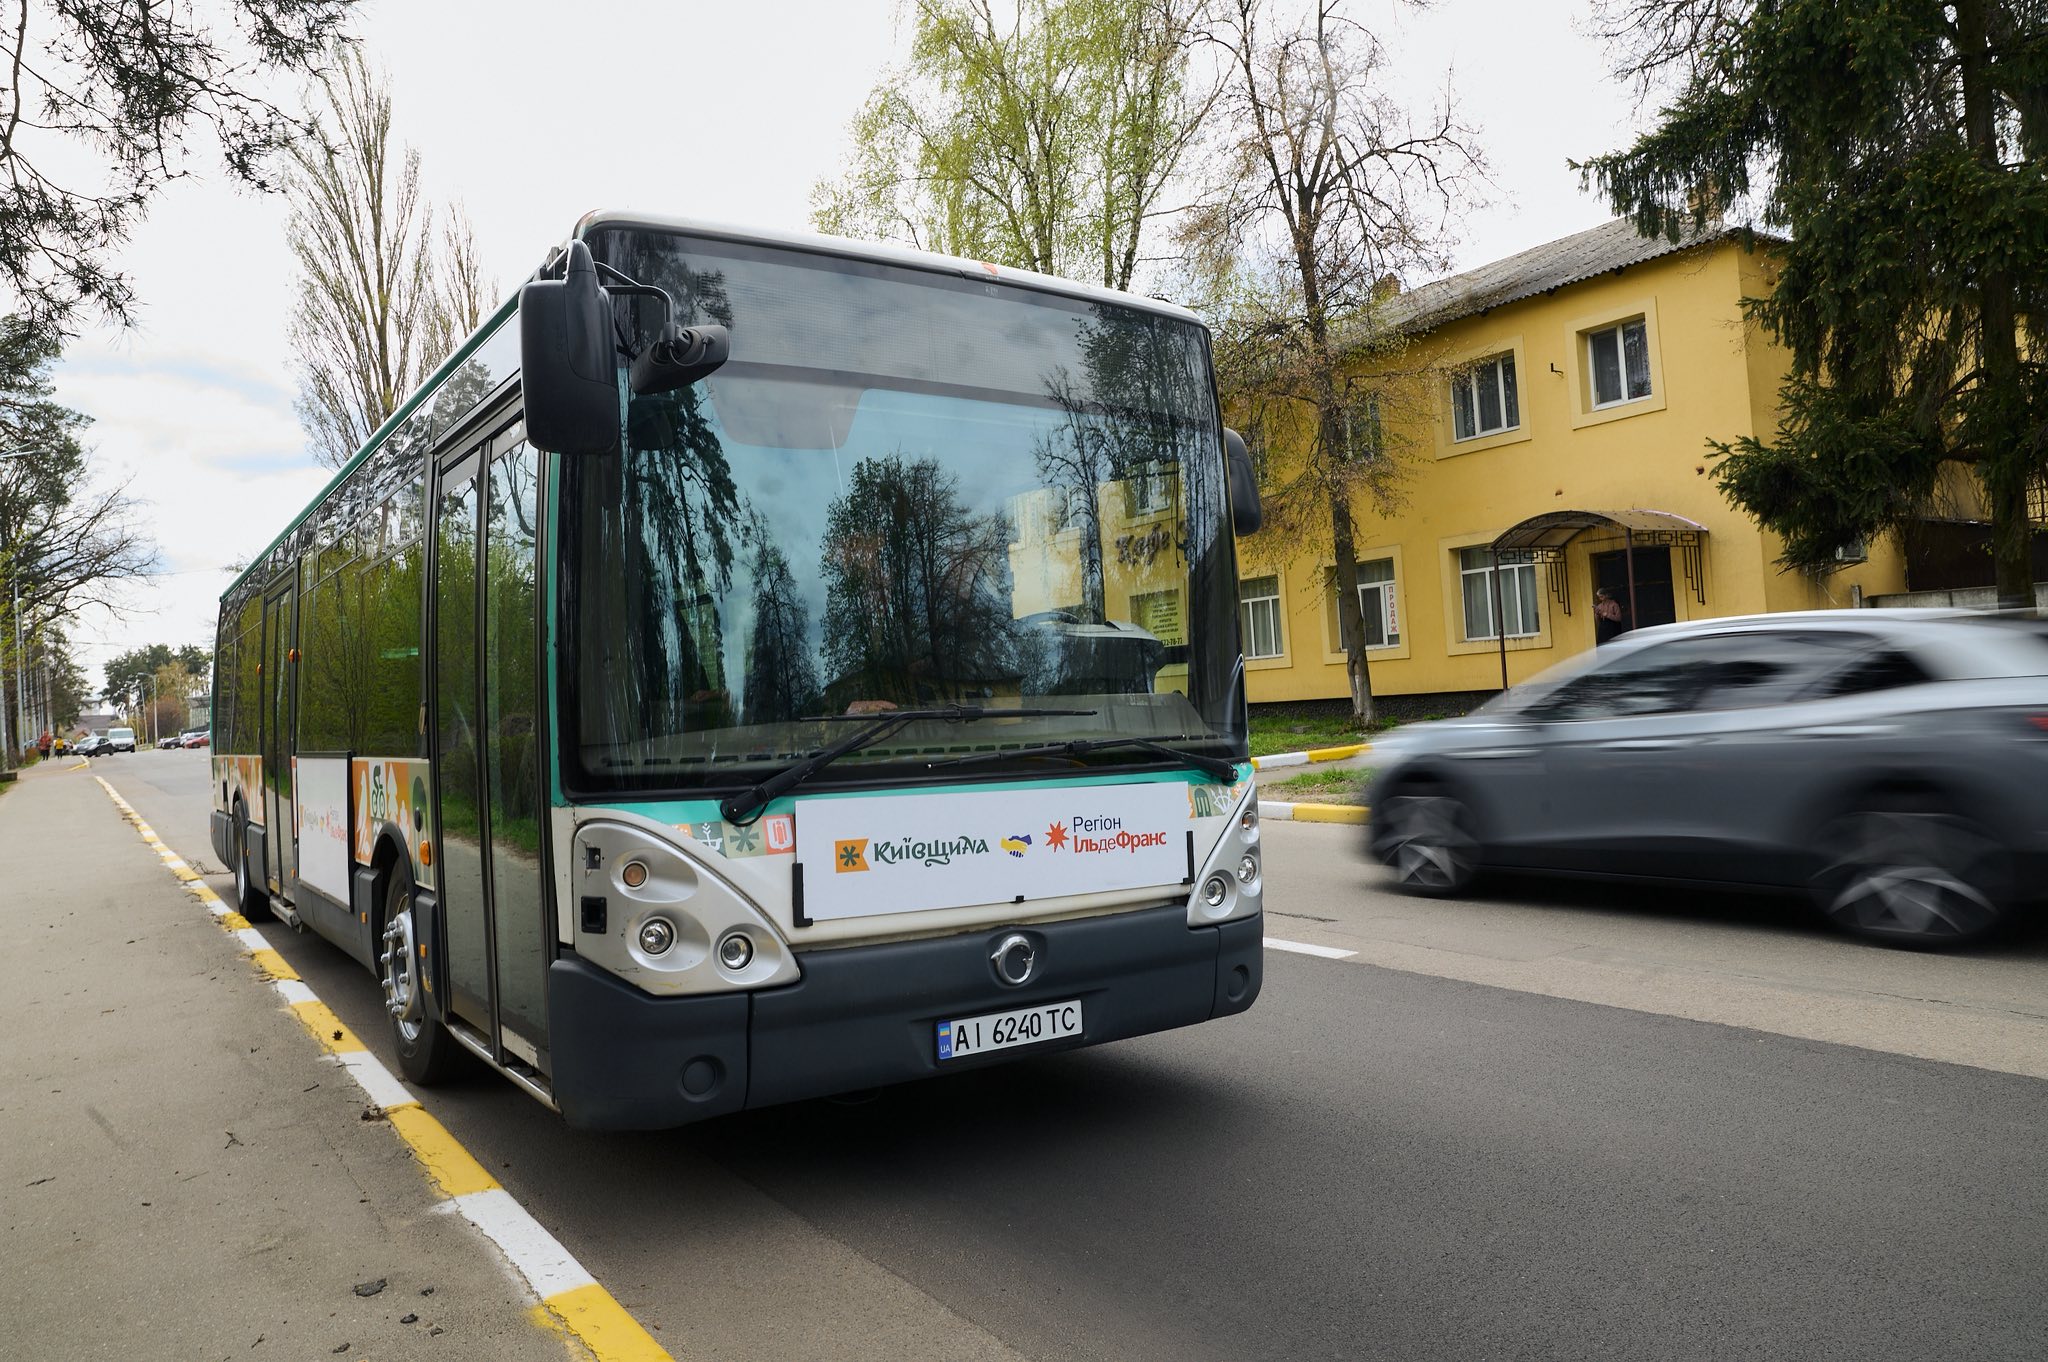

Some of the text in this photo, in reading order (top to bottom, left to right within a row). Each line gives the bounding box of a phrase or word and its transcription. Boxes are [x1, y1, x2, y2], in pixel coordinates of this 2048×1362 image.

[1389, 586, 1397, 632] ПРОДАЖ
[1073, 814, 1121, 832] Регіон
[874, 836, 989, 867] Київщина
[1073, 831, 1167, 853] ІльдеФранс
[955, 1006, 1076, 1051] AI 6240 TC
[940, 1045, 951, 1053] UA
